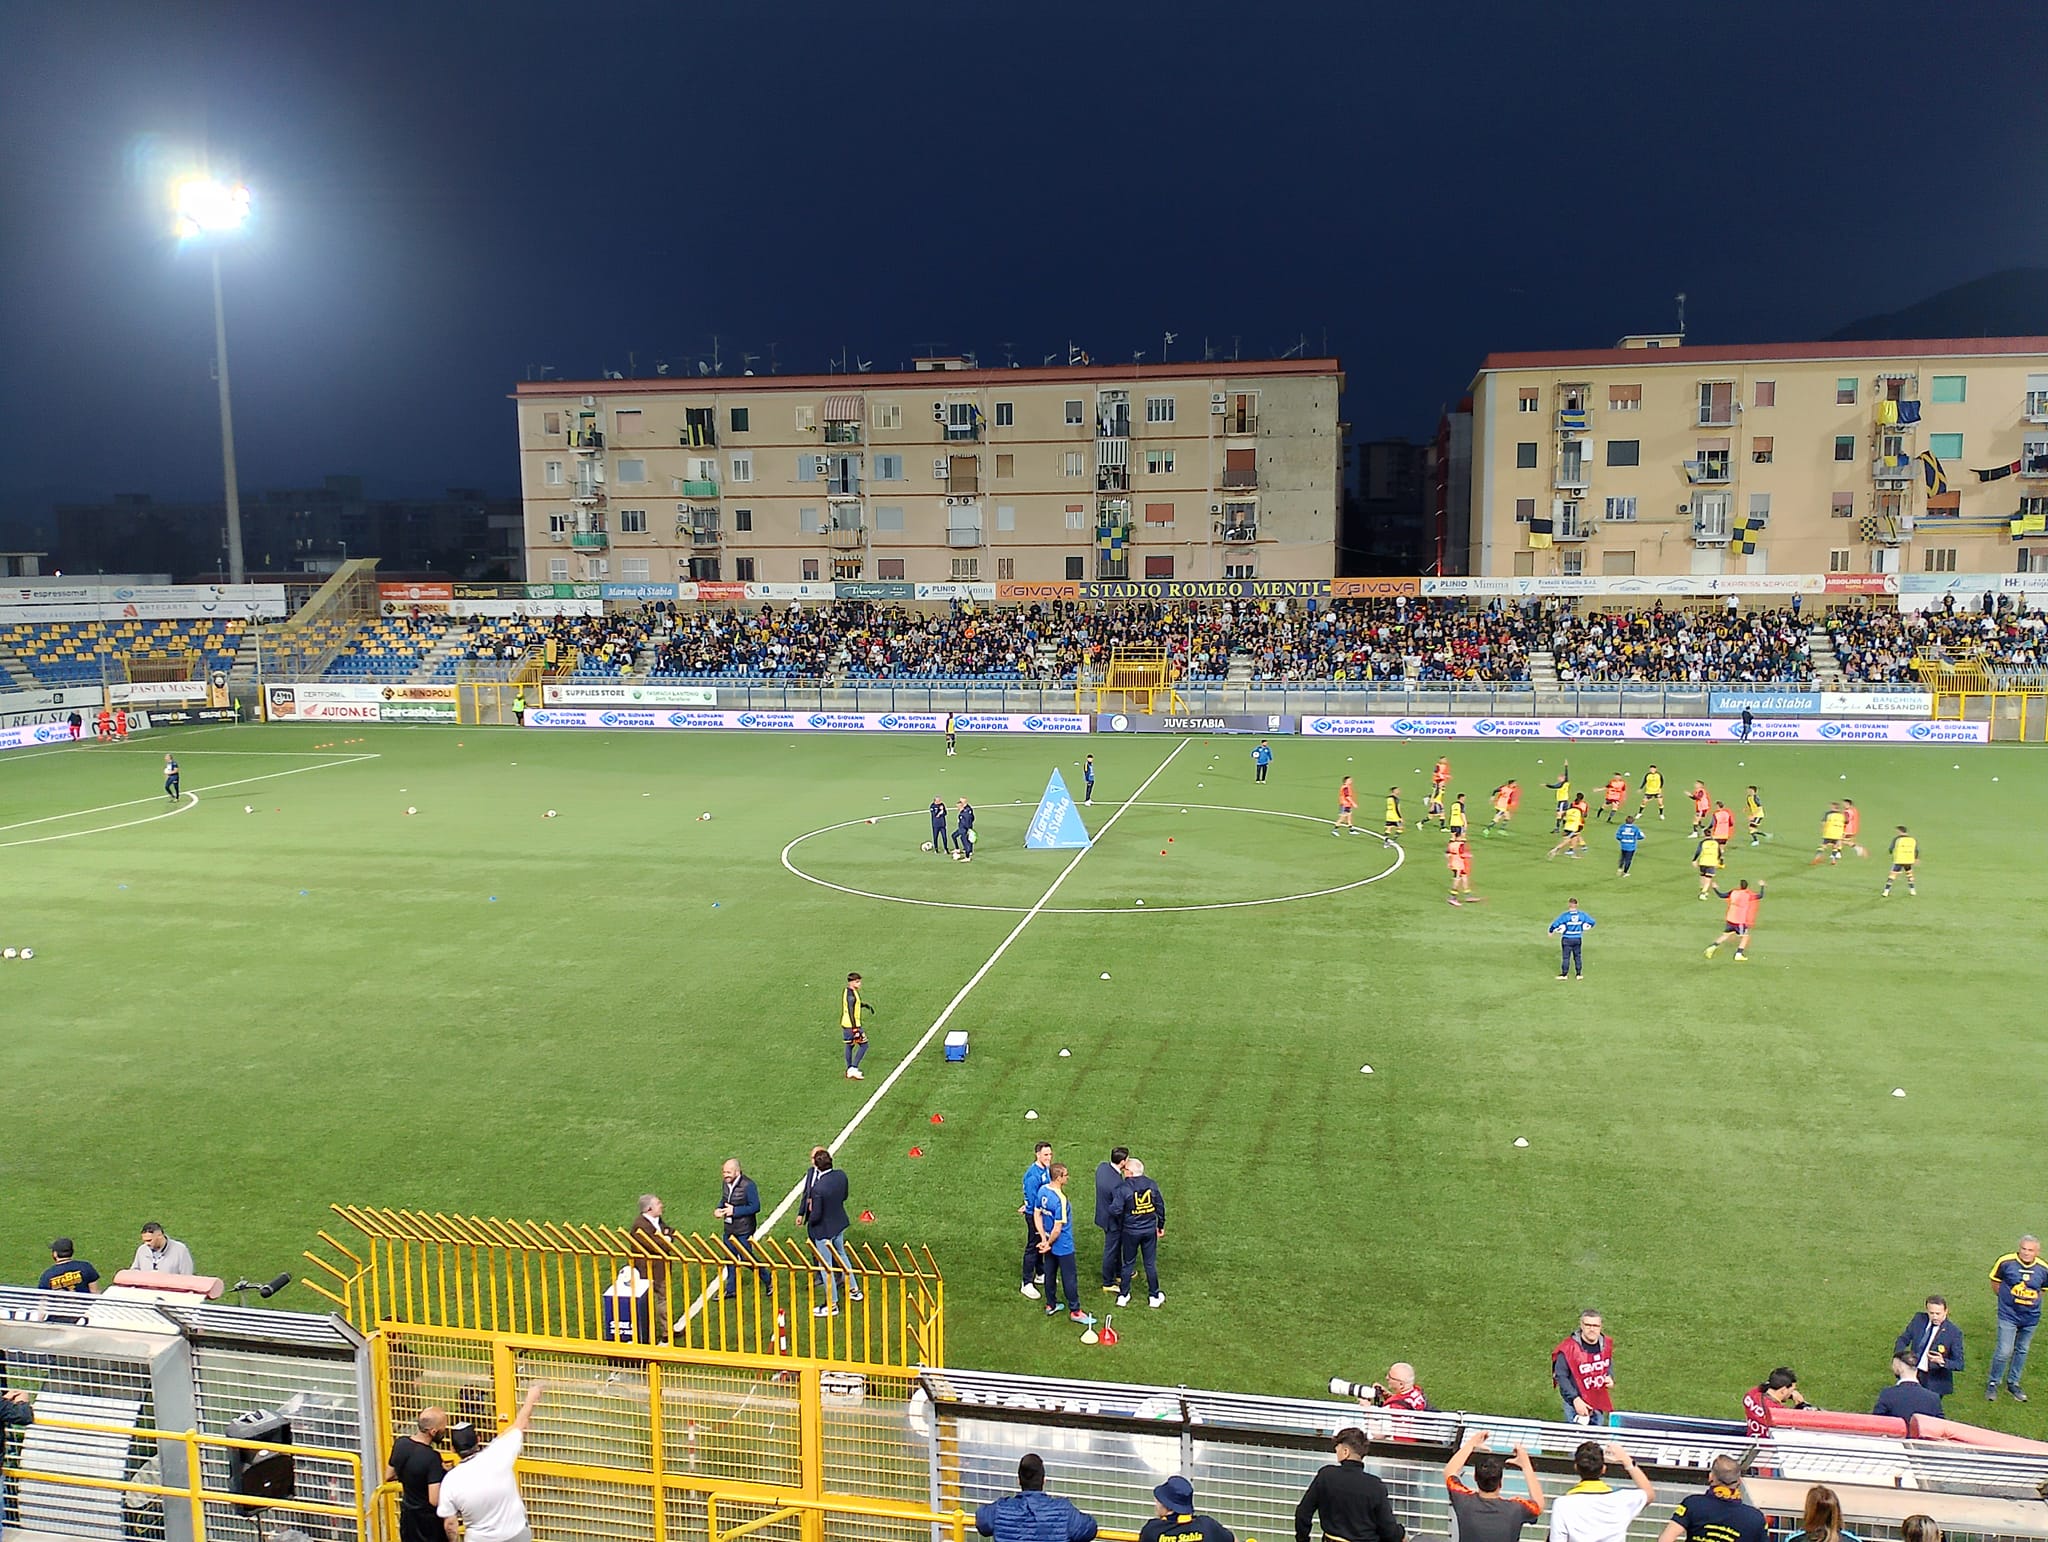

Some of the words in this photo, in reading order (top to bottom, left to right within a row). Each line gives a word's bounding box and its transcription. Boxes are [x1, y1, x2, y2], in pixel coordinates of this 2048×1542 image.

[608, 586, 636, 596] Marina
[637, 586, 646, 596] di
[646, 586, 673, 596] Stabia
[1014, 586, 1074, 596] GIVOVA
[1090, 583, 1162, 598] STADIO
[1168, 582, 1243, 597] ROMEO
[1252, 582, 1320, 596] MENTI
[1350, 583, 1415, 592] GIVOVA
[130, 684, 166, 694] PASTA
[397, 688, 407, 697] LA
[1720, 698, 1760, 708] Marina
[1760, 697, 1772, 708] di
[1776, 697, 1812, 708] Stabia
[13, 714, 49, 727] REAL
[1163, 718, 1188, 728] JUVE
[1189, 718, 1225, 728] STABIA
[1048, 796, 1070, 834] Stabia
[1031, 800, 1055, 842] Marina
